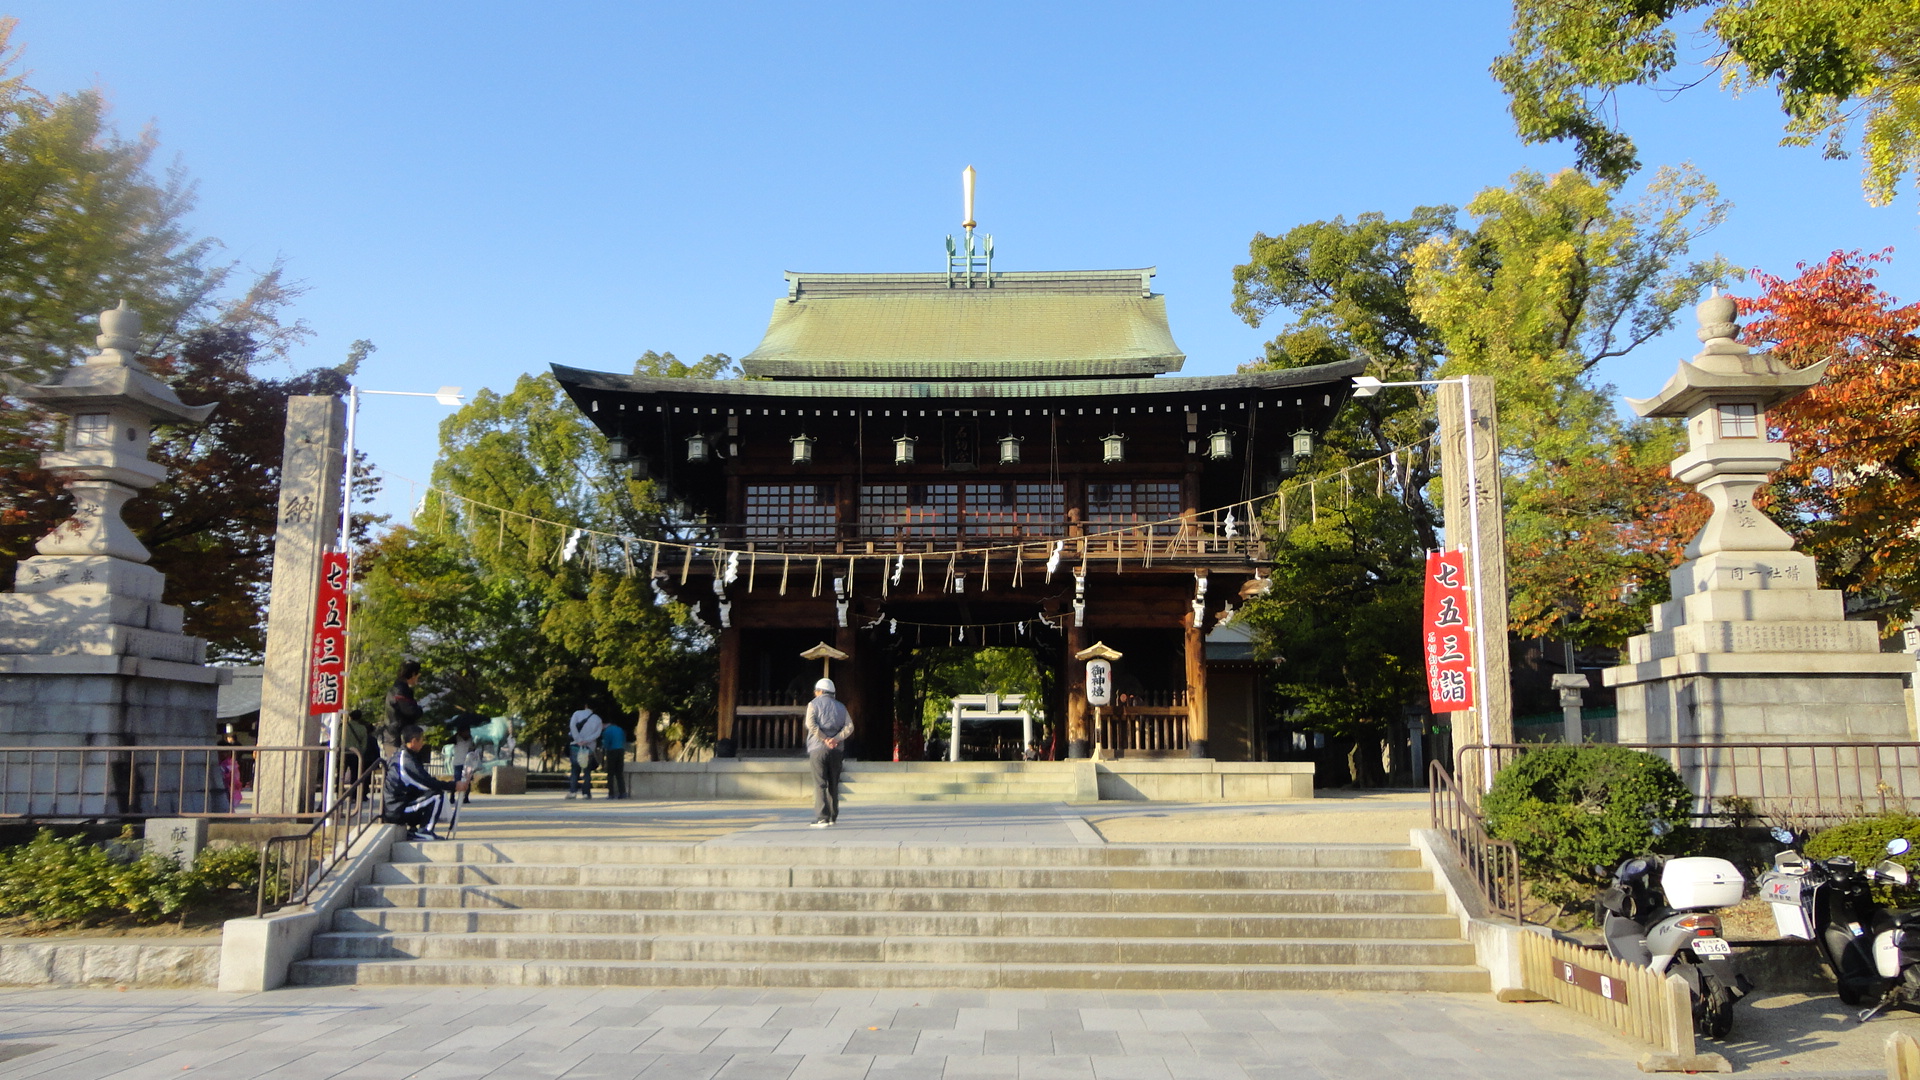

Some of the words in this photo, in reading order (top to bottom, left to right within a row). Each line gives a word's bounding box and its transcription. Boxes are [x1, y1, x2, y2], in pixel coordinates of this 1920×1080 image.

[318, 561, 343, 705] 七五三詣
[1433, 562, 1466, 701] 七五三詣
